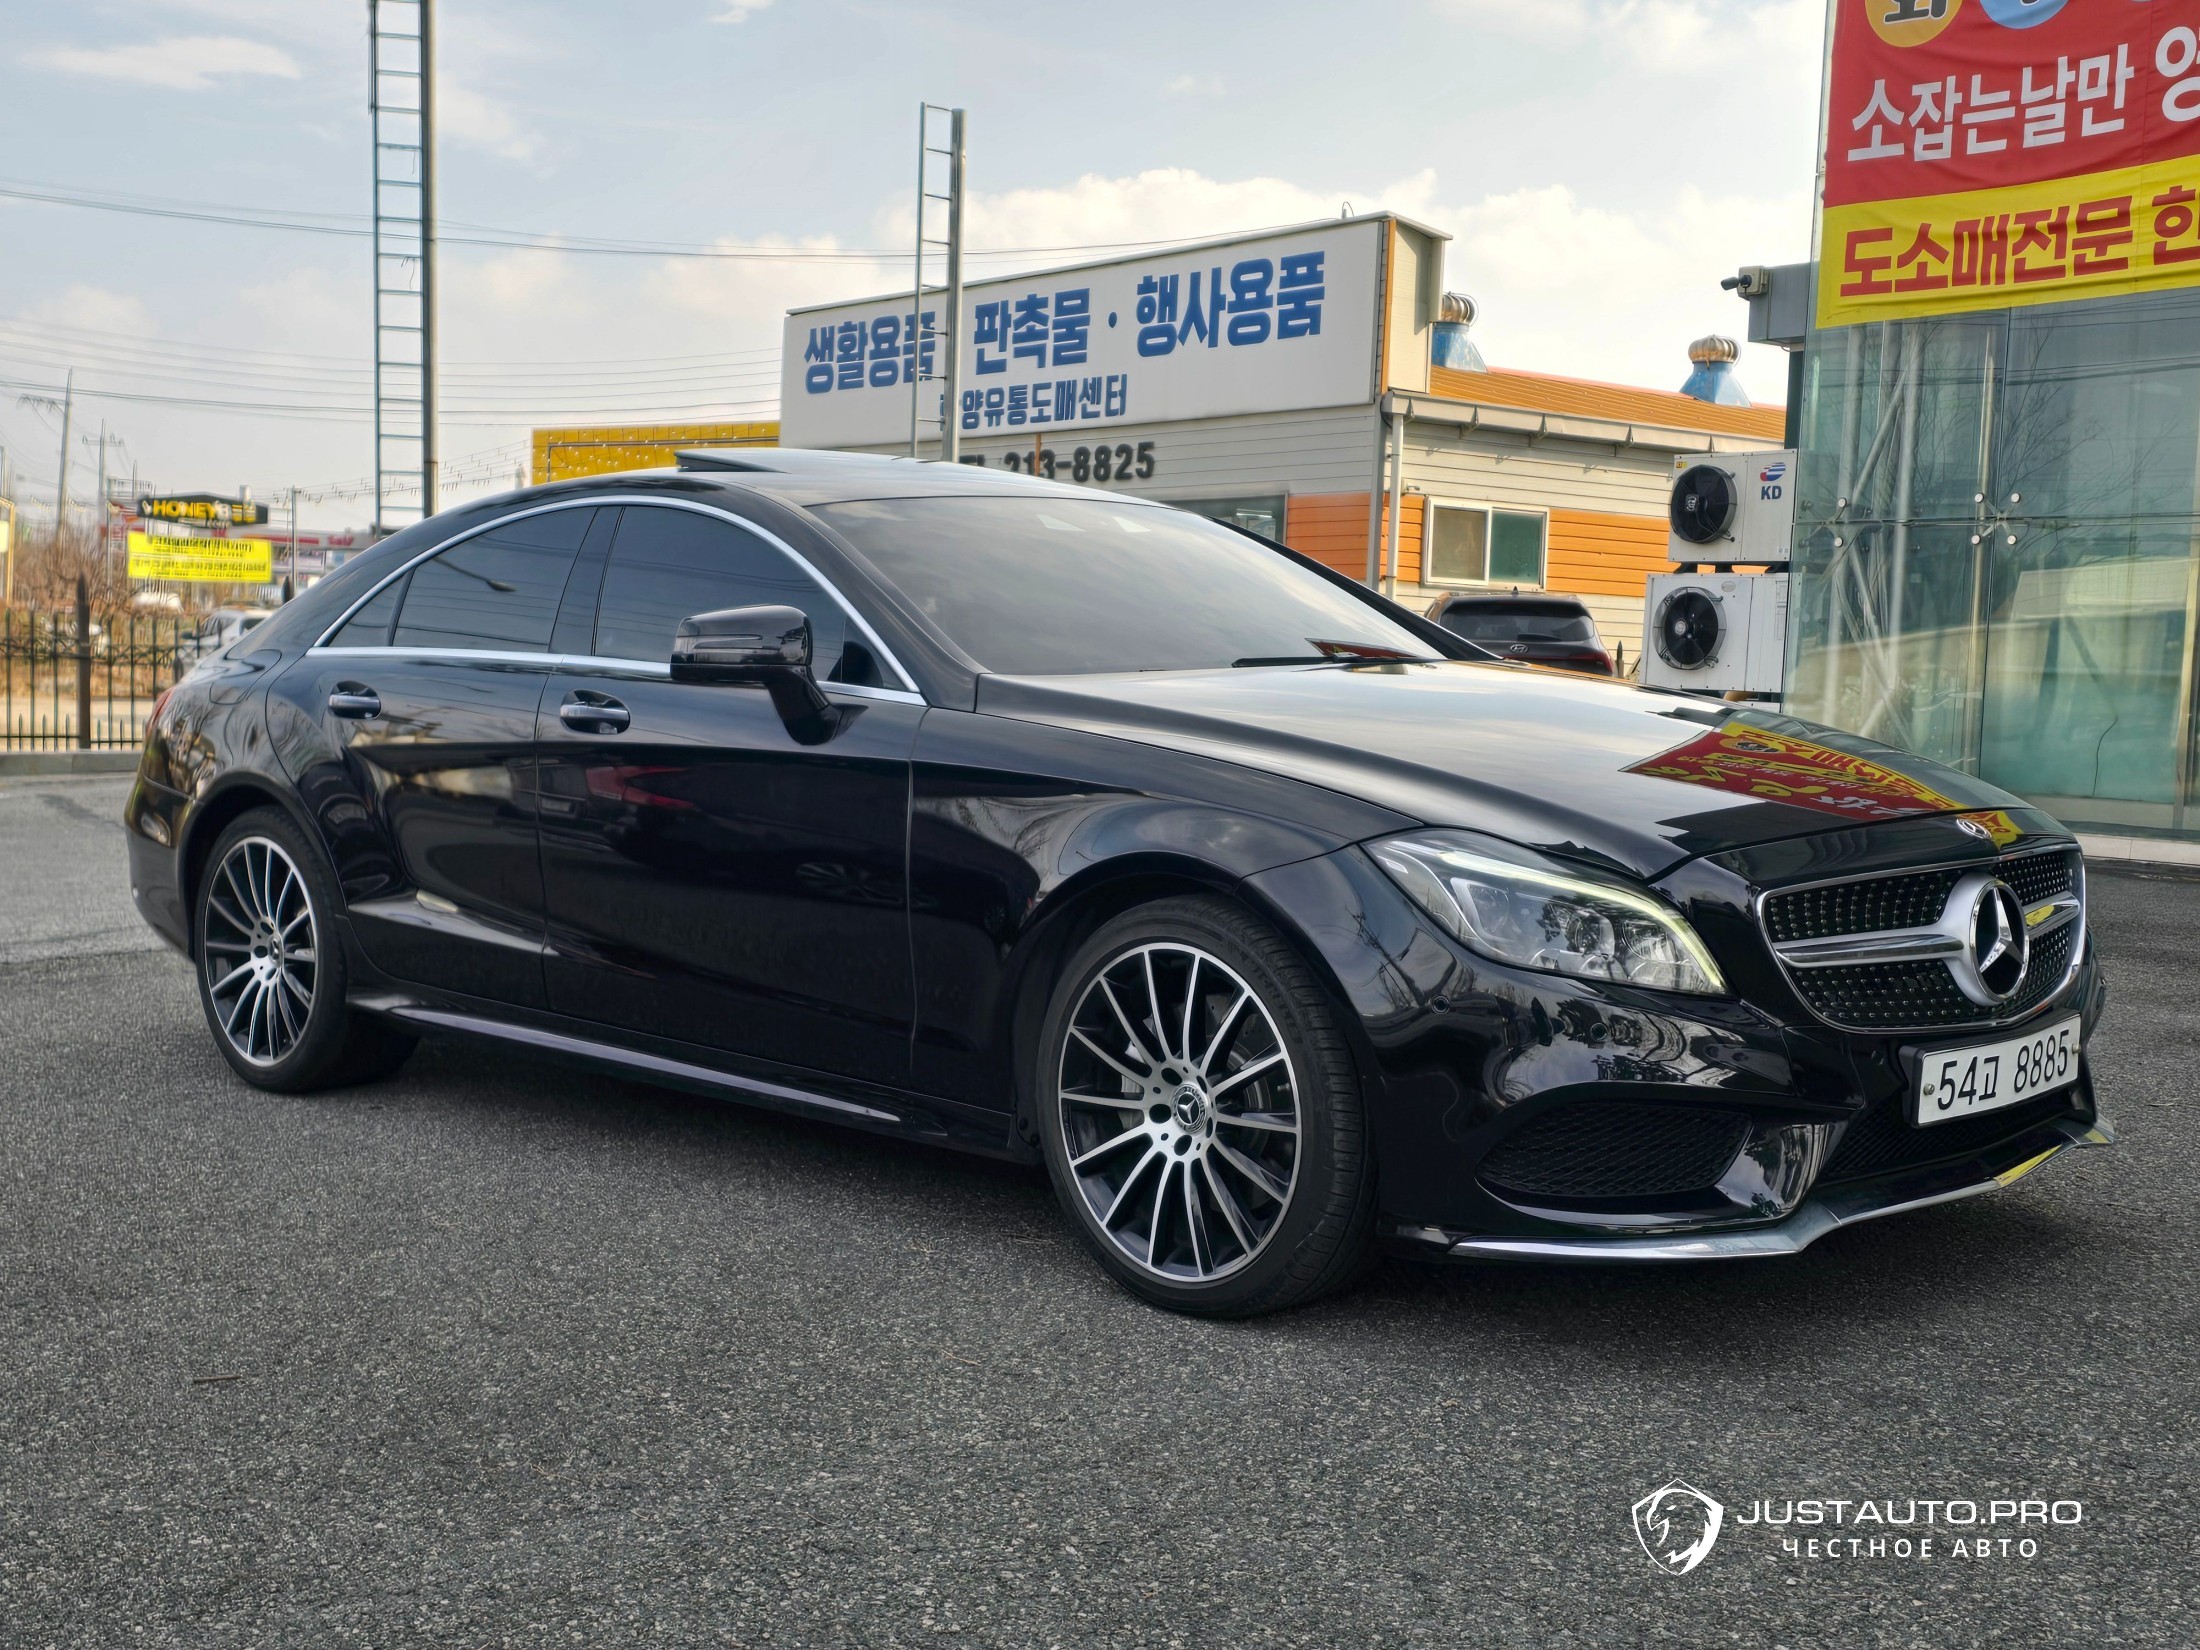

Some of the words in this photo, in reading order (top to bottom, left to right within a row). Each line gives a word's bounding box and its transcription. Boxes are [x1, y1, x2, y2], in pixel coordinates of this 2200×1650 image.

[1847, 42, 2135, 162] 소잡는날만
[1839, 195, 2134, 297] 도소매전문
[803, 310, 936, 395] 생활용품
[973, 287, 1091, 376] 판촉물
[1136, 250, 1326, 358] 행사용품
[939, 373, 1128, 431] 양유통도매센터
[1760, 485, 1783, 500] KD
[1937, 1055, 2000, 1110] 54고
[2014, 1029, 2070, 1093] 8885
